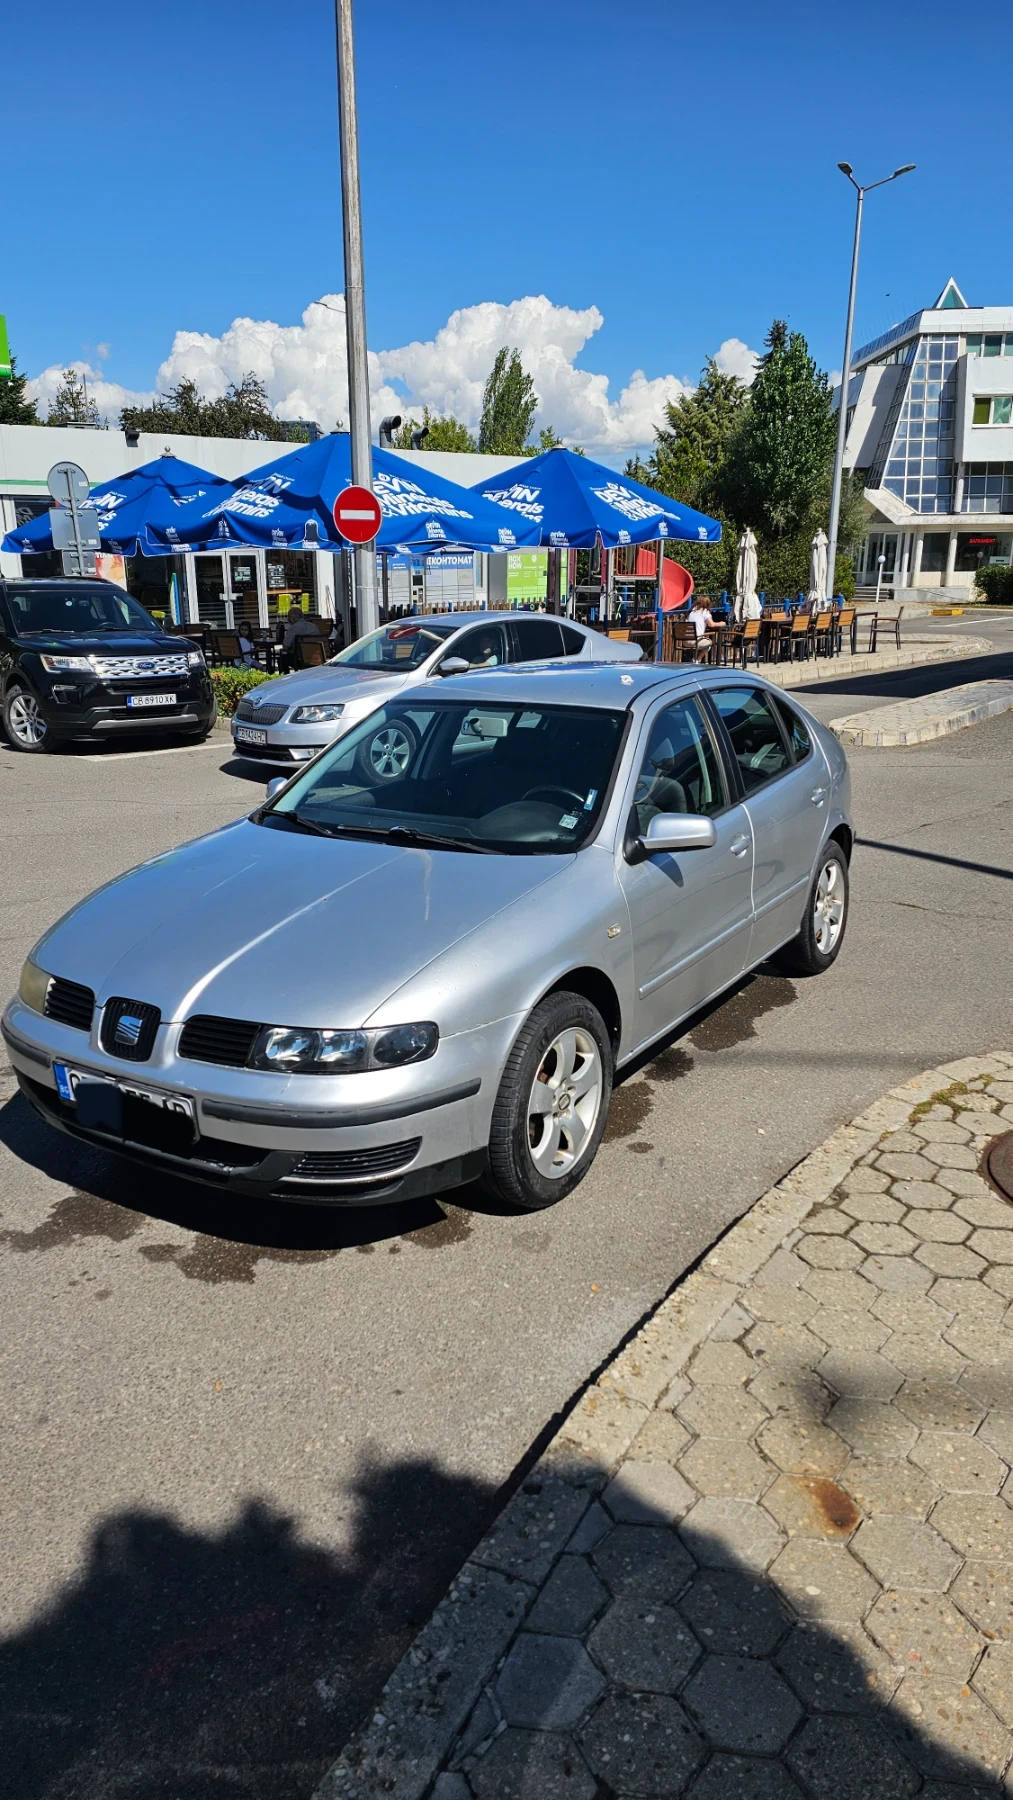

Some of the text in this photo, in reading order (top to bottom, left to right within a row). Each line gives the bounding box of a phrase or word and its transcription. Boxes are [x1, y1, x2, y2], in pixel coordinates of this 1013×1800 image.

[372, 477, 427, 496] EVIN
[132, 694, 175, 706] CB 8910 XK
